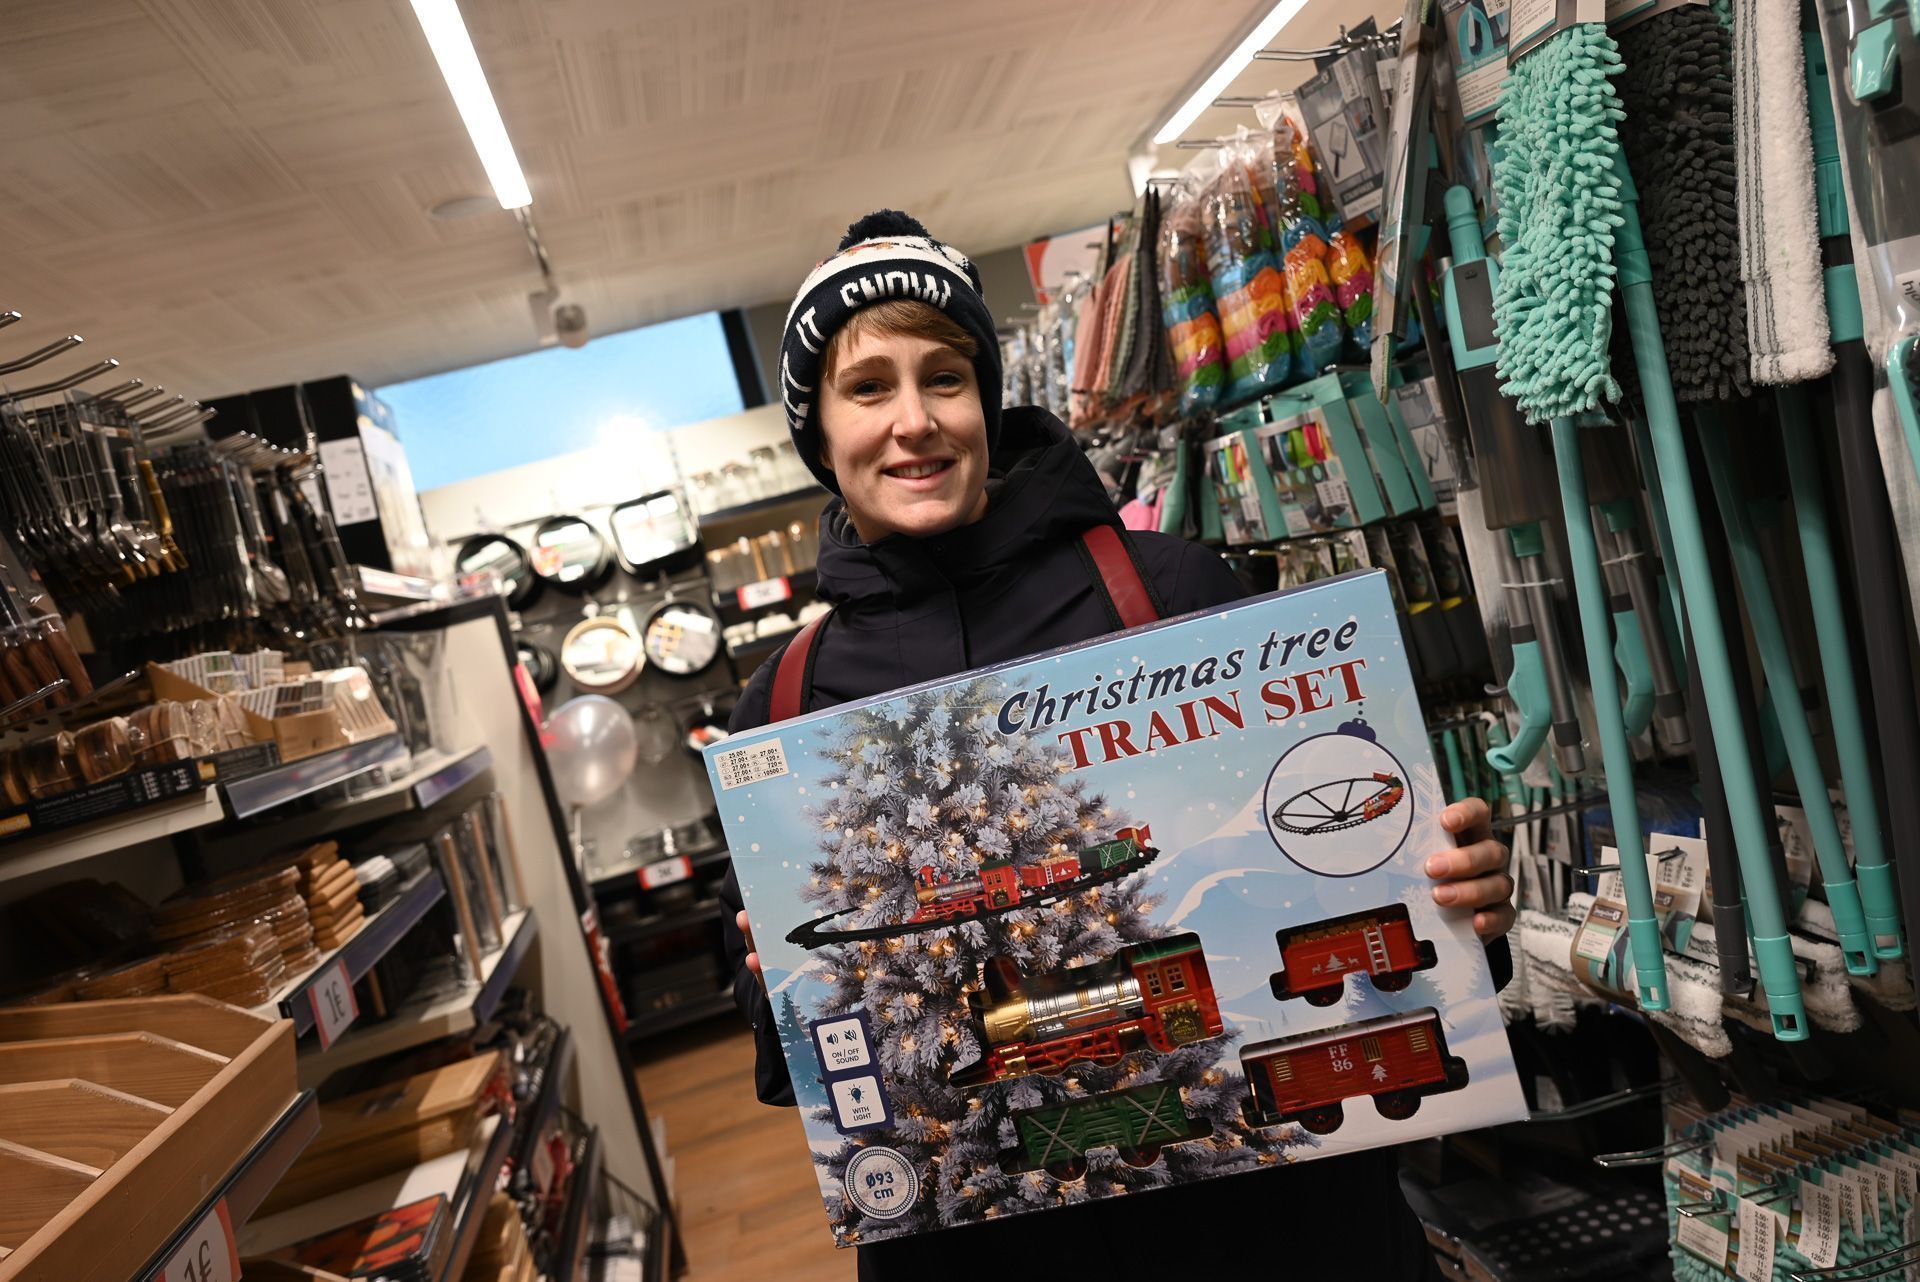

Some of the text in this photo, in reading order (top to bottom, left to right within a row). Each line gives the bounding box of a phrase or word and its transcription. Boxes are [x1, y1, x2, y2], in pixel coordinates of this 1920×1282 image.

[795, 306, 826, 355] IT
[997, 649, 1245, 736] Christmas
[1258, 620, 1358, 672] tree
[1057, 658, 1367, 771] TRAIN SET
[325, 981, 345, 1024] 1€
[831, 1051, 843, 1059] ON
[845, 1048, 860, 1056] OFF
[836, 1055, 859, 1064] SOUND
[1328, 1043, 1349, 1060] FF
[1332, 1058, 1353, 1073] 86
[852, 1106, 870, 1115] WITH
[853, 1112, 872, 1122] LIGHT
[866, 1170, 894, 1189] Ø93
[873, 1187, 895, 1200] cm
